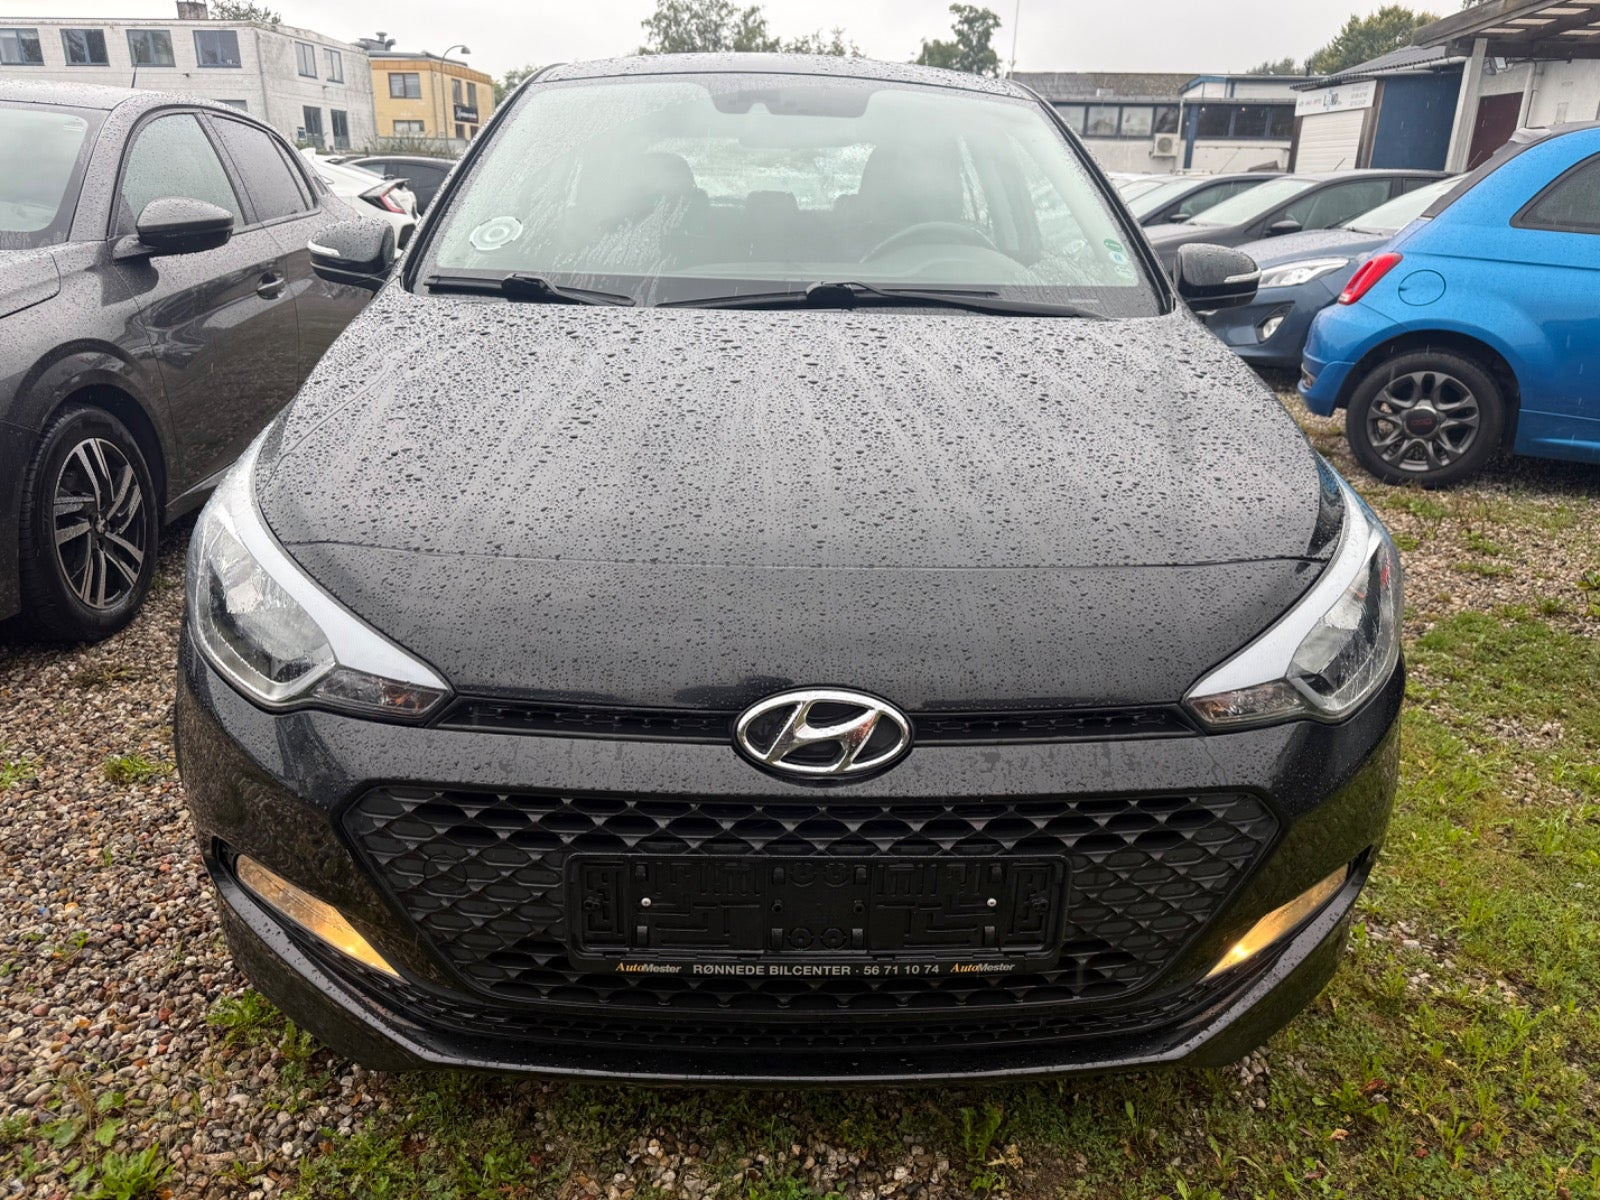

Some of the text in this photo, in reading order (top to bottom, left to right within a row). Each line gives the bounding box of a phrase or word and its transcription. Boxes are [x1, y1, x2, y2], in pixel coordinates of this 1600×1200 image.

[616, 962, 682, 974] AutoMester
[693, 964, 940, 976] RØNNEDE BILCENTER 56 71 10 74
[950, 962, 1016, 974] AutoMester
